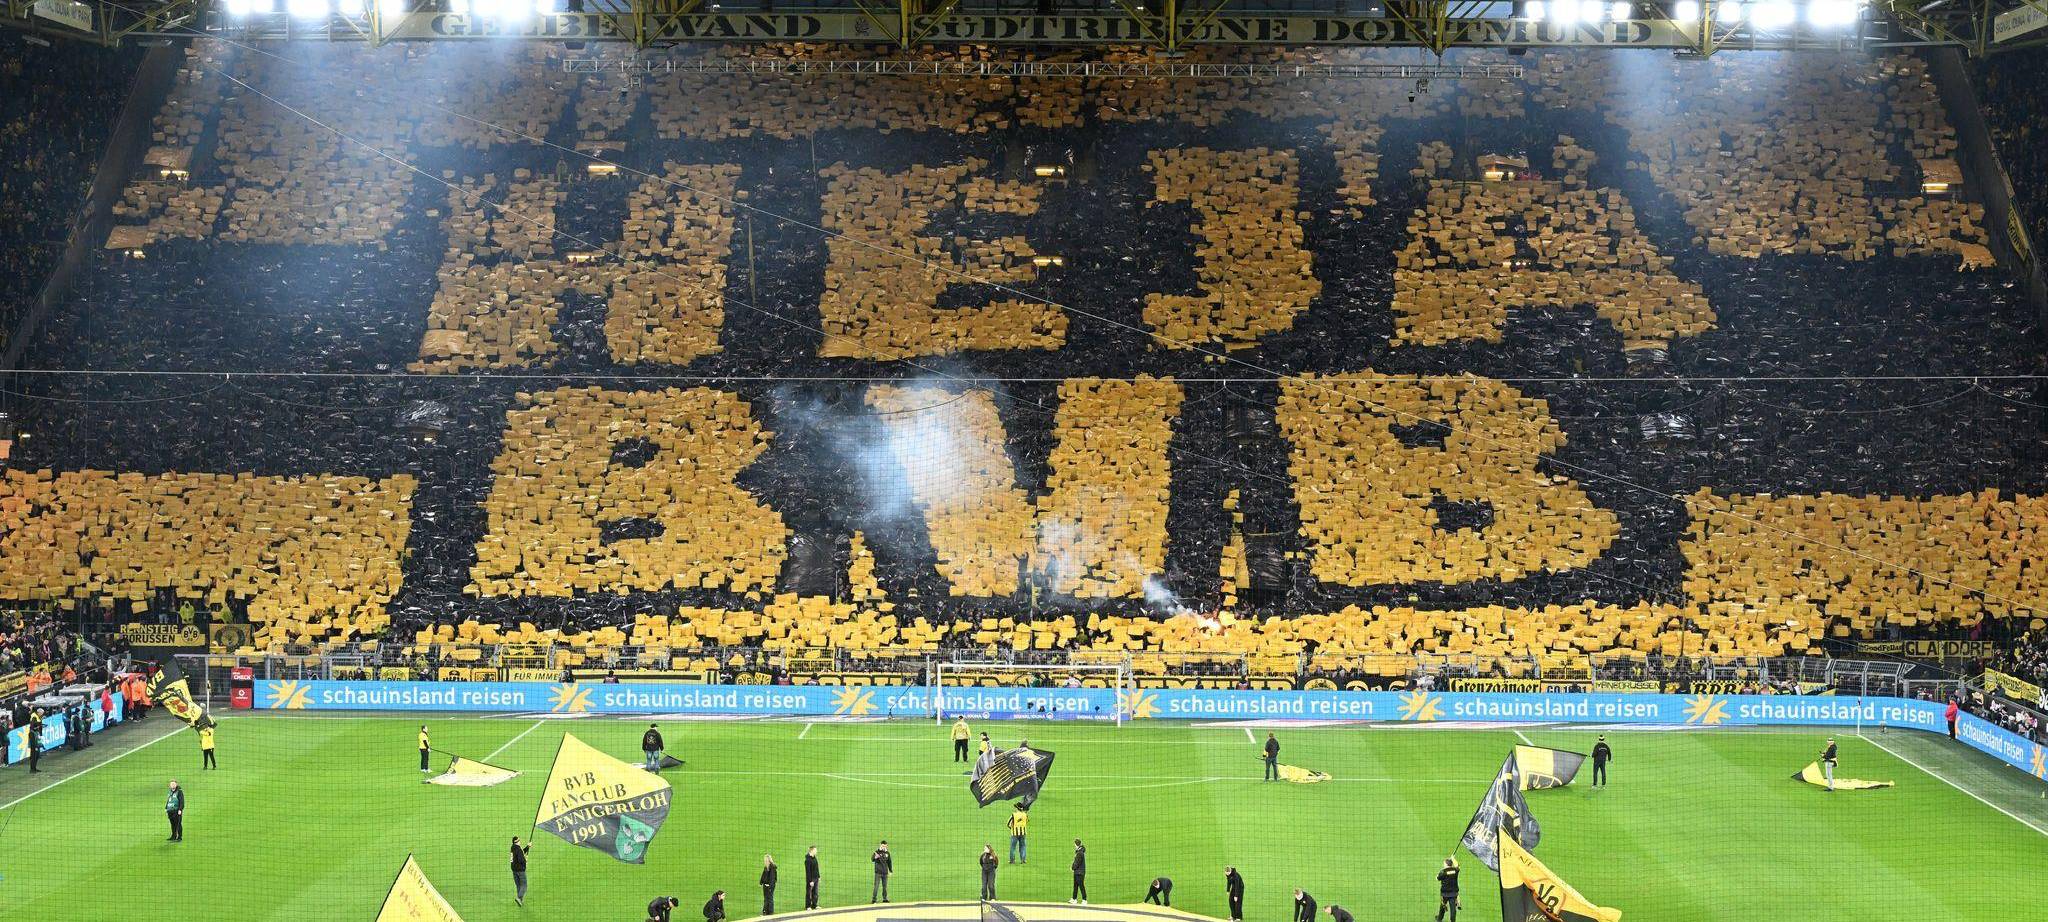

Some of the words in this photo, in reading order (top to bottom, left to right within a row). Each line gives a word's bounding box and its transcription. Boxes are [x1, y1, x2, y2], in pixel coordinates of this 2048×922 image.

[652, 15, 822, 37] WAND
[911, 15, 1288, 40] SÜDTRIBÜNE
[1312, 18, 1652, 43] DORTMUND
[407, 140, 1718, 371] HEJA
[468, 370, 1622, 602] BVB
[323, 686, 455, 704] schauinsland
[463, 687, 525, 704] reisen
[605, 689, 737, 707] schauinsland
[744, 691, 806, 708] reisen
[1027, 695, 1090, 712] reisen
[1170, 695, 1304, 712] schauinsland
[1311, 697, 1373, 713] reisen
[1455, 698, 1588, 715] schauinsland
[1596, 699, 1659, 716] reisen
[1740, 701, 1875, 719] schauinsland
[1882, 706, 1935, 725] reisen
[1962, 722, 2003, 753] schauinsland
[2003, 738, 2024, 760] reisen
[564, 771, 596, 791] BVB
[551, 783, 627, 813] FANCLUB
[555, 791, 668, 833] ENNIGERLOH
[571, 822, 607, 844] 1991
